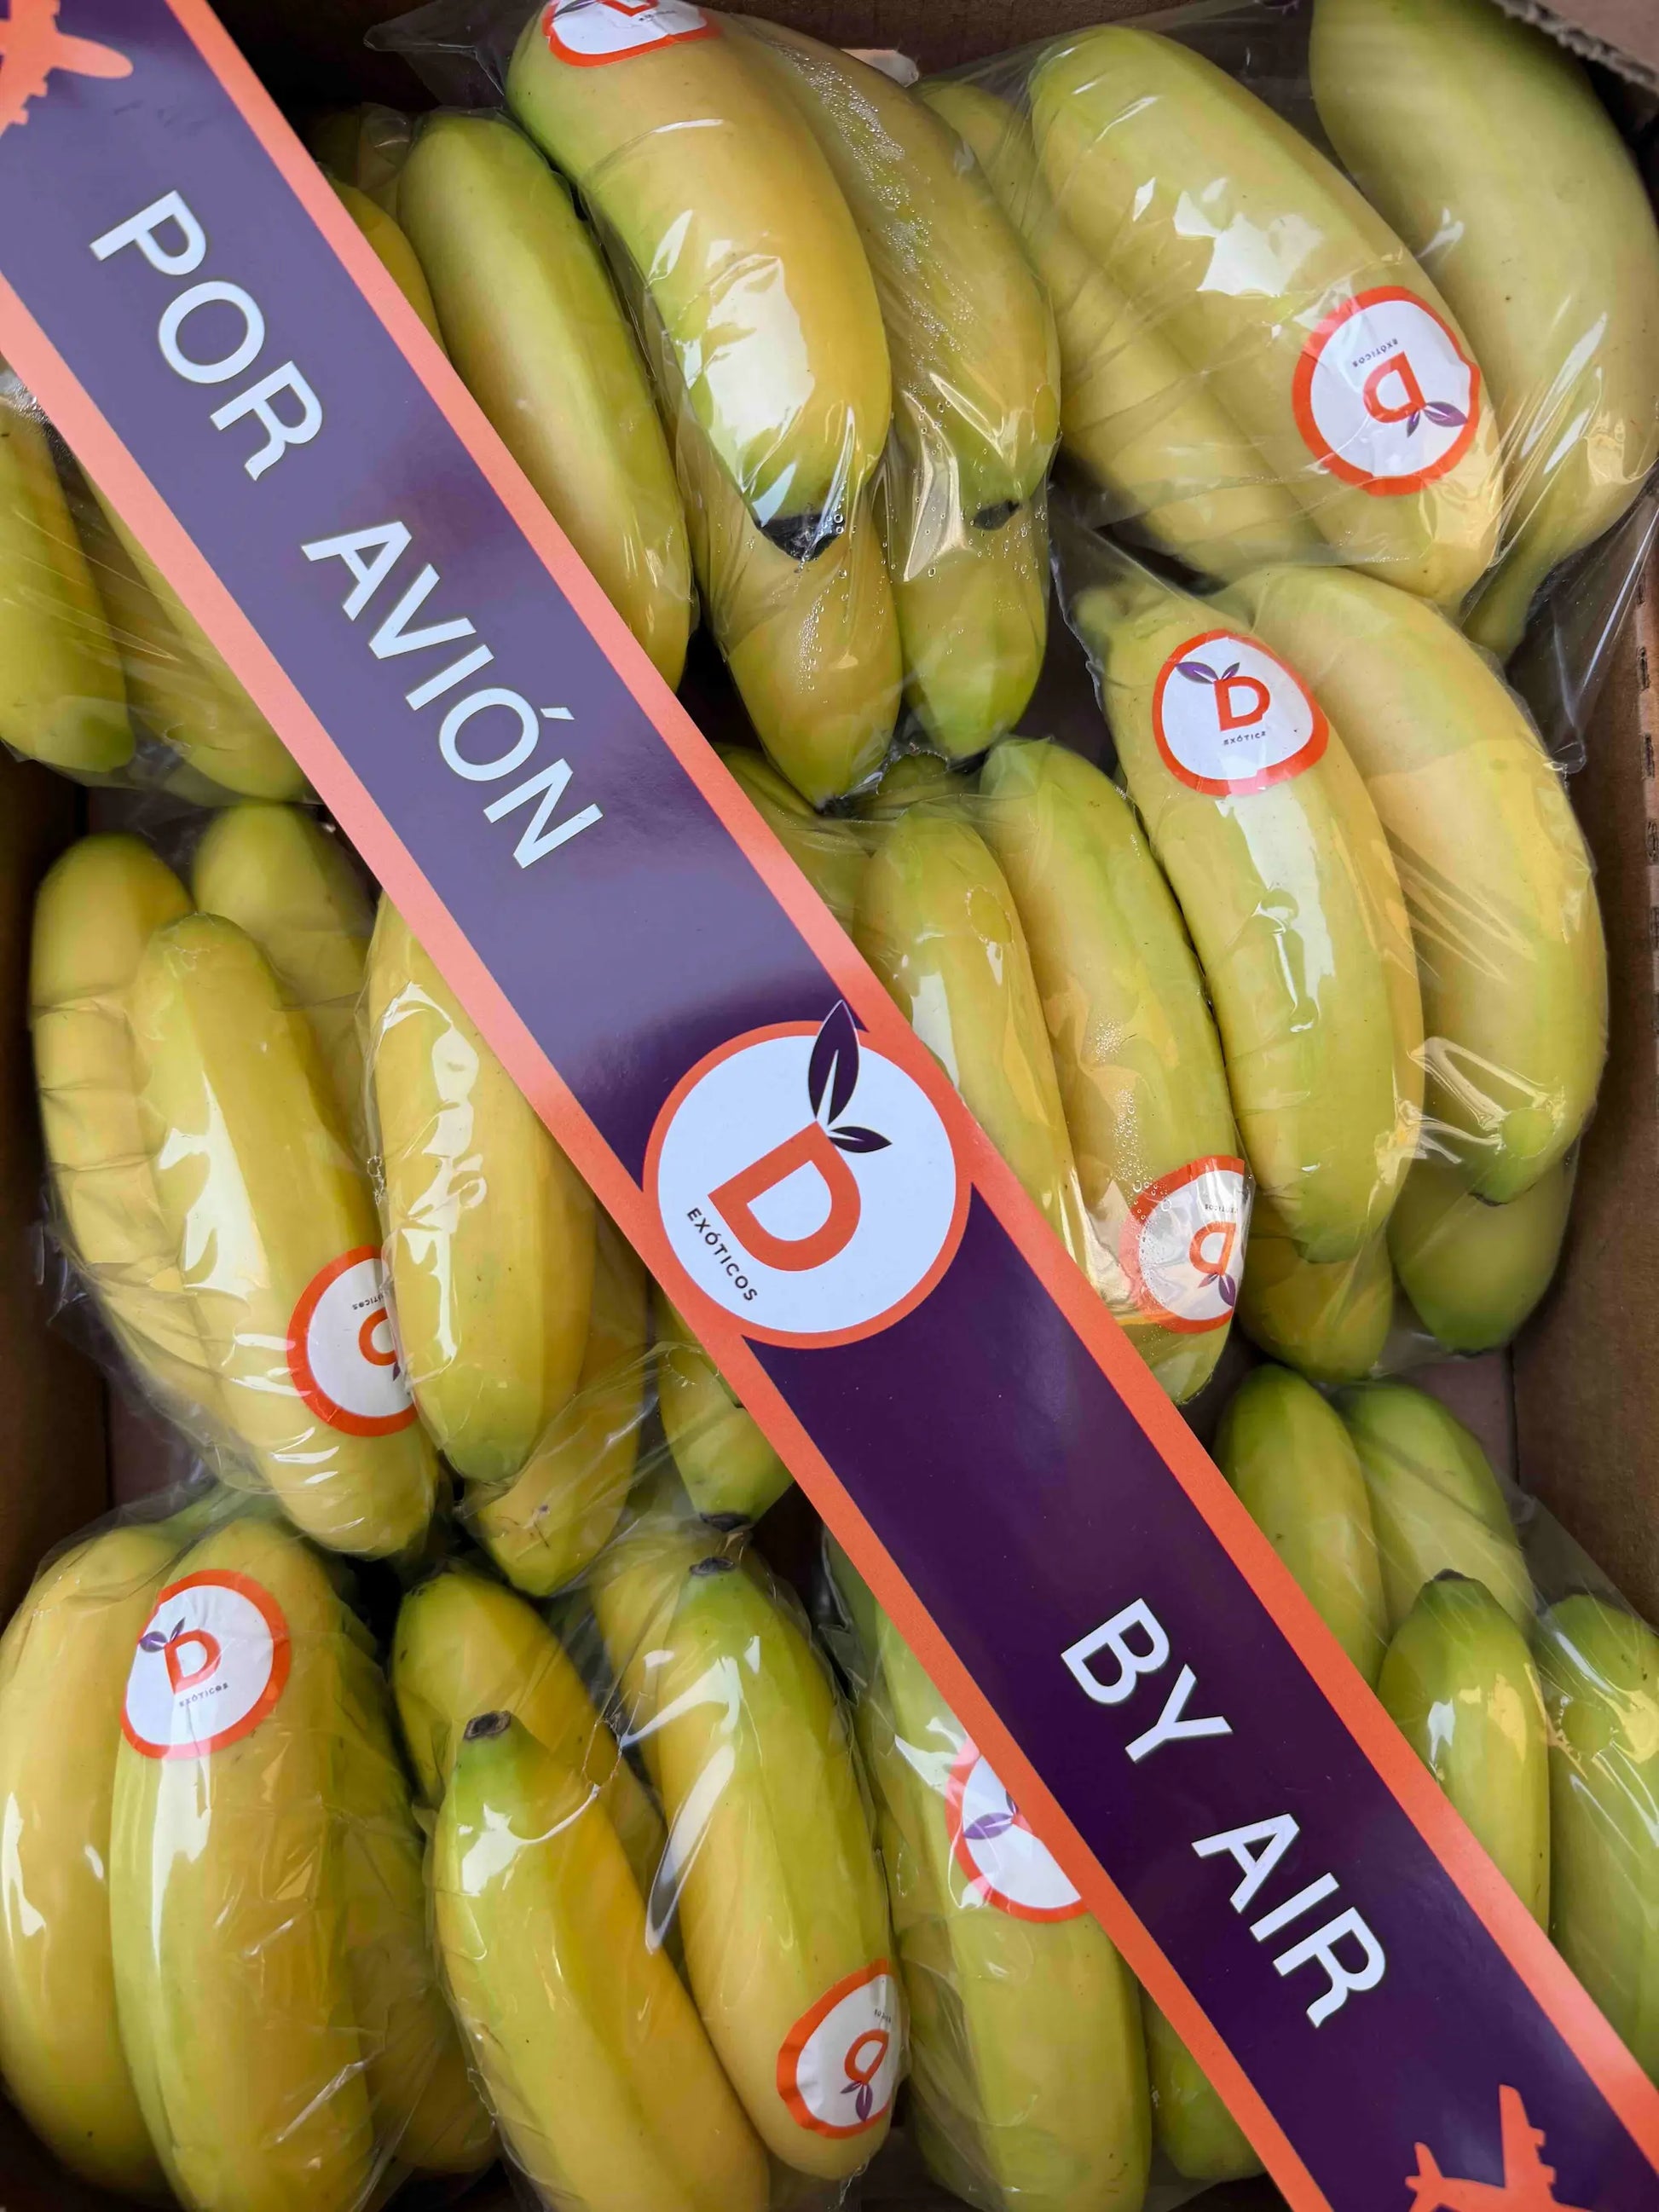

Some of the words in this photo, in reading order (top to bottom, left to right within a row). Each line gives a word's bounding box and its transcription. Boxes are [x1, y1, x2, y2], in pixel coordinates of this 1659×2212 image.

[1353, 338, 1399, 367] EXÓTICOS
[1363, 351, 1426, 424] D
[89, 189, 323, 482] POR
[300, 520, 604, 869] AVIÓN
[1214, 676, 1270, 732] D
[708, 1121, 861, 1272] D
[686, 1207, 758, 1302] EXÓTICOS
[1189, 1221, 1236, 1275] D
[164, 1629, 222, 1695] D
[179, 1682, 228, 1707] EXÓTICOS
[1060, 1597, 1233, 1763] BY
[1191, 1813, 1386, 2028] AIR
